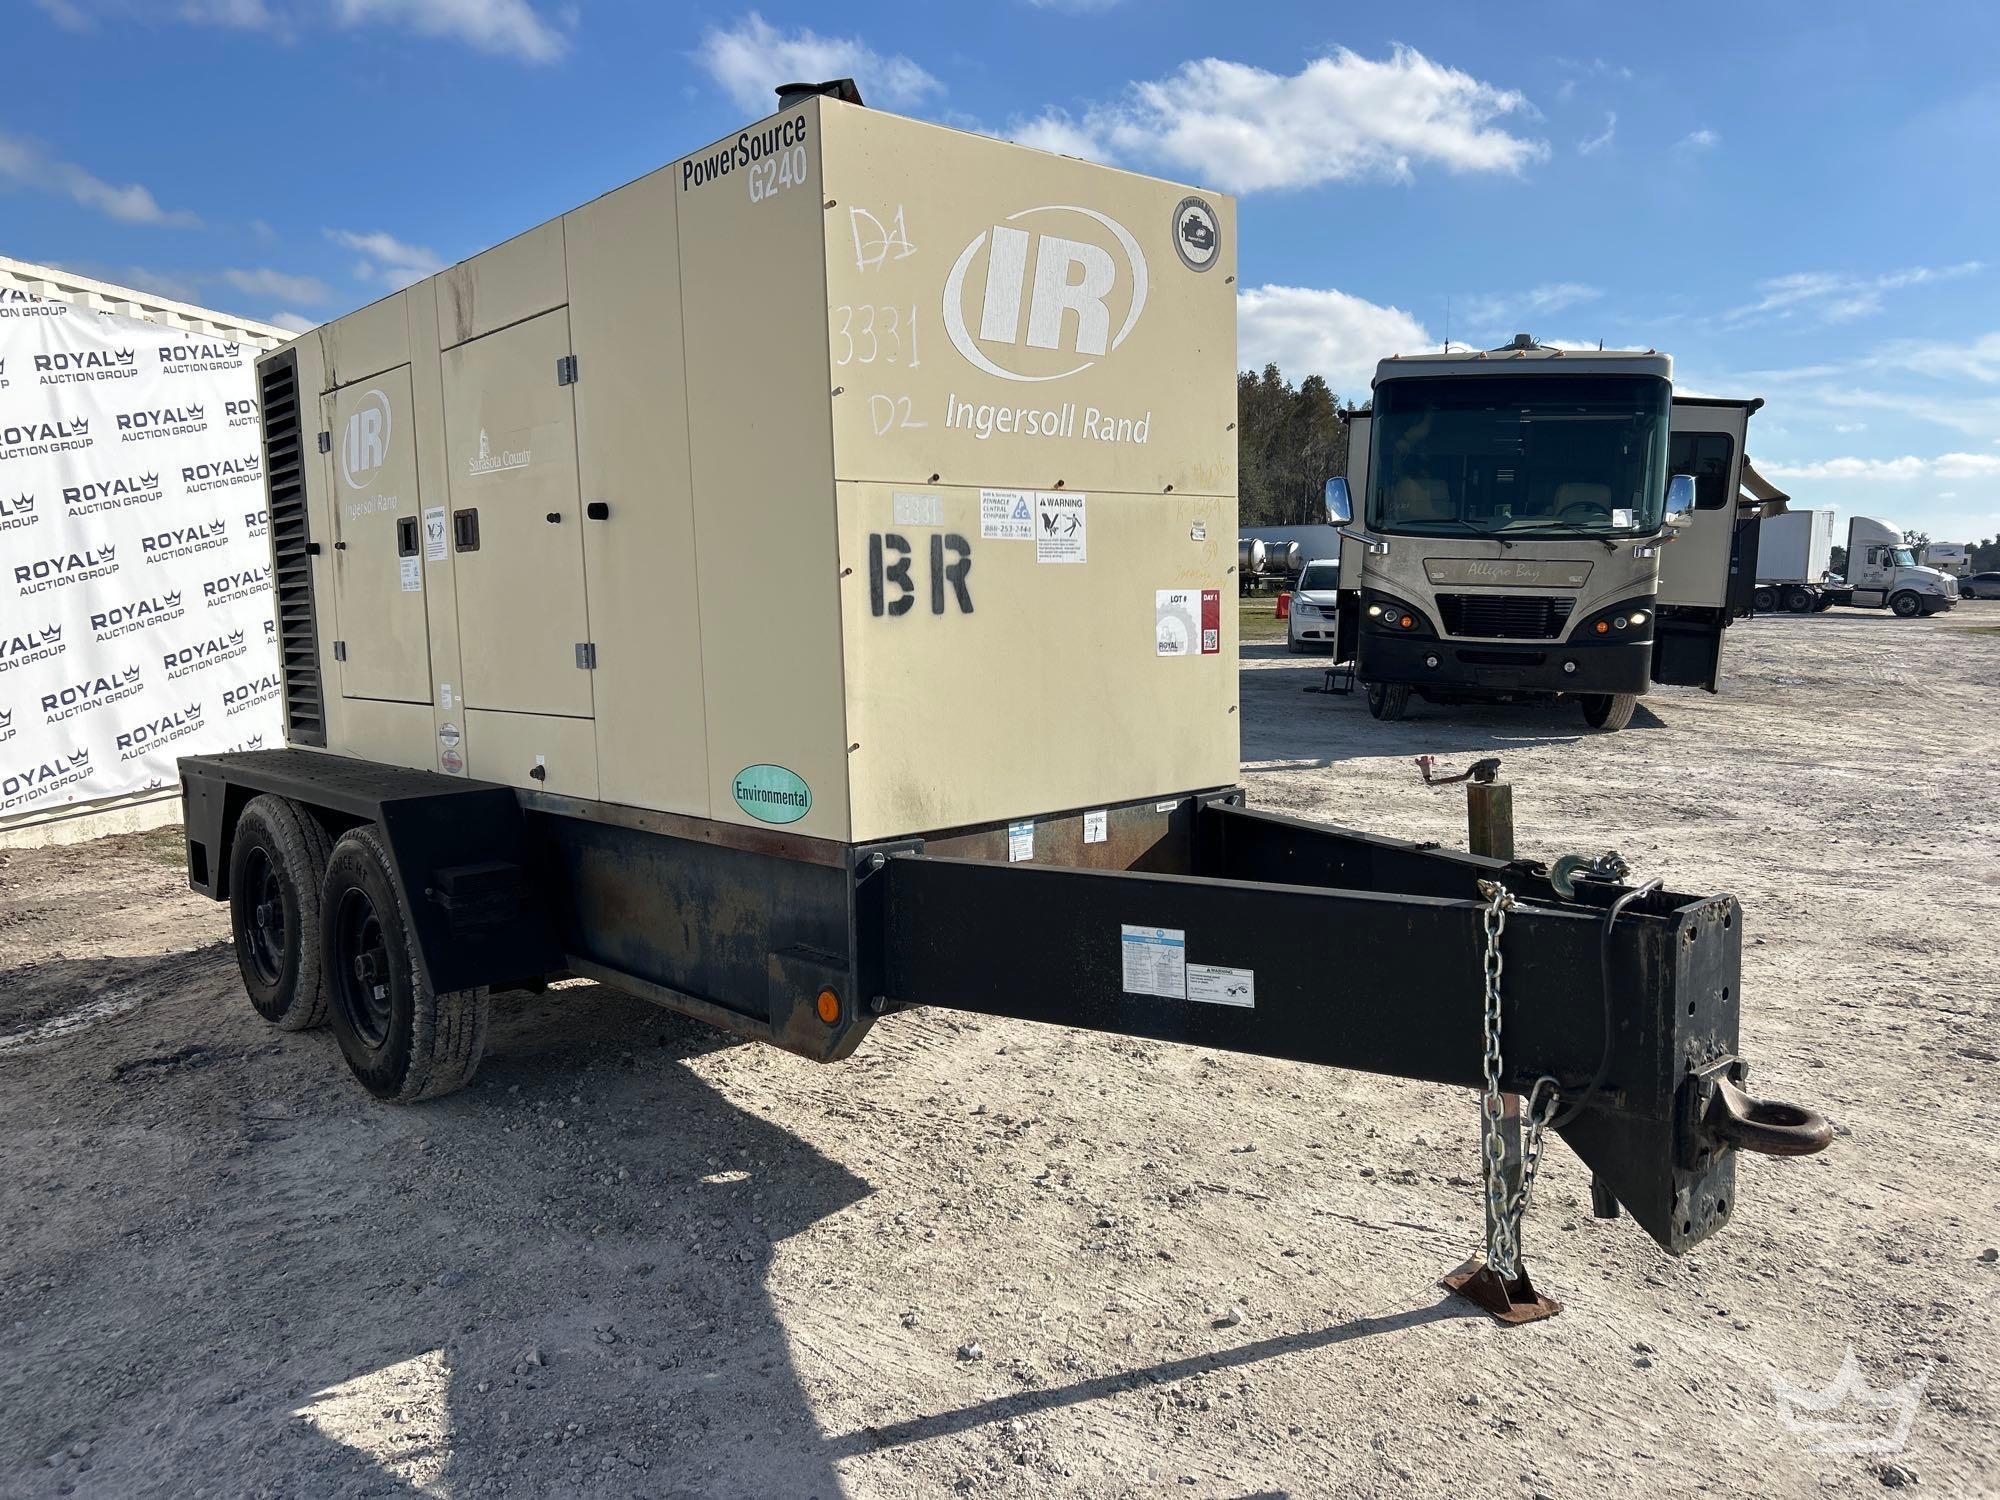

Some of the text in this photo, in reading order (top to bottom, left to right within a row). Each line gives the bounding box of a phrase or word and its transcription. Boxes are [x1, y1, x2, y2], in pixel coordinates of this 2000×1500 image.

[683, 115, 806, 192] PowerSource
[749, 146, 808, 203] G240
[979, 224, 1116, 357] IR
[22, 306, 67, 317] GROUP
[831, 303, 921, 368] 3331
[34, 351, 116, 371] ROYAL
[158, 344, 225, 362] ROYAL
[40, 369, 138, 385] AUCTION GROUP
[163, 360, 243, 374] AUCTION GROUP
[116, 407, 188, 430] ROYAL
[868, 395, 928, 437] D2
[945, 393, 1151, 444] Ingersoll Rand
[50, 438, 94, 452] GROUP
[121, 423, 208, 443] AUCTION GROUP
[350, 408, 383, 473] IR
[181, 459, 245, 482] ROYAL
[469, 449, 531, 472] Sarasota County
[62, 478, 142, 504] ROYAL
[186, 472, 263, 494] AUCTION GROUP
[68, 491, 163, 517] AUCTION GROUP
[983, 512, 1010, 520] COMPANY
[1046, 499, 1083, 508] WARNING
[0, 515, 39, 531] ROUP
[141, 525, 210, 552] ROYAL
[146, 537, 229, 564] AUCTION GROUP
[14, 551, 99, 583] ROYAL
[1467, 563, 1511, 582] Allegro
[1515, 562, 1540, 582] Bay
[20, 564, 120, 597] AUCTION GROUP
[203, 568, 264, 597] ROYAL
[207, 589, 249, 608] AUCTION
[1170, 595, 1183, 603] LOT
[1203, 593, 1214, 601] DAY
[90, 598, 164, 630] ROYAL
[96, 609, 185, 643] AUCTION GROUP
[22, 644, 66, 665] GROUP
[163, 637, 230, 670] ROYAL
[1159, 641, 1178, 649] ROYAL
[168, 646, 247, 681] AUCTION GROUP
[41, 674, 125, 712] ROYAL
[222, 673, 281, 706] ROYAL
[46, 683, 144, 725] AUCTION GROUP
[226, 694, 267, 717] AUCTION
[115, 712, 186, 750] ROYAL
[121, 720, 205, 762] AUCTION GROUP
[50, 767, 94, 791] GROUP
[736, 780, 808, 808] Environmental
